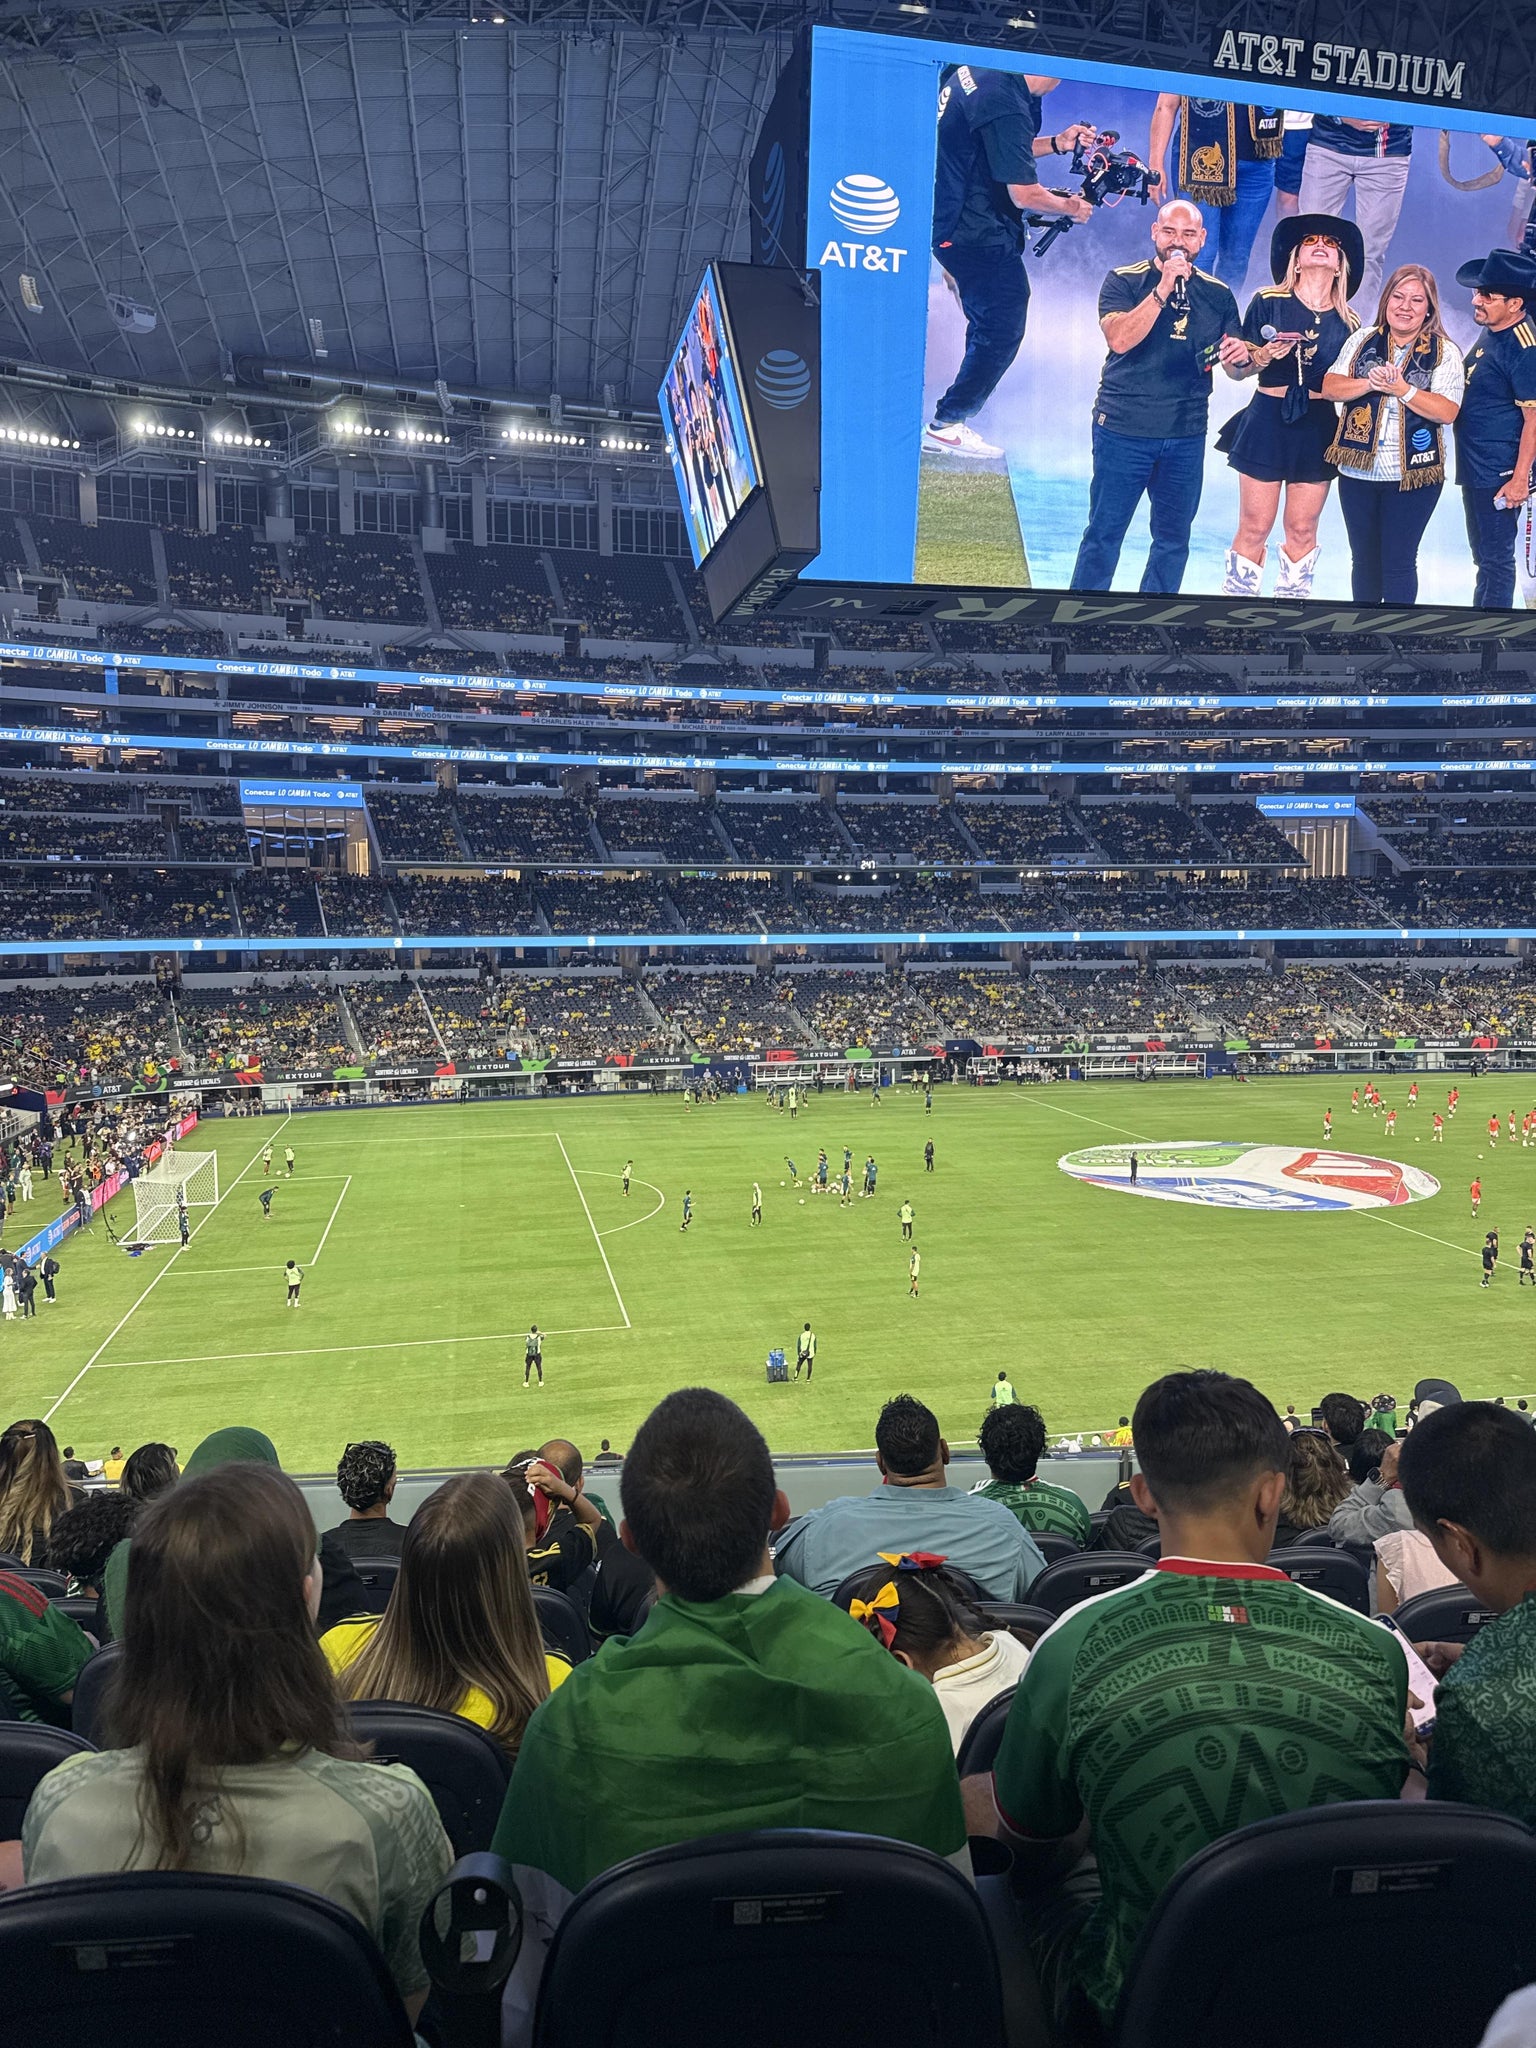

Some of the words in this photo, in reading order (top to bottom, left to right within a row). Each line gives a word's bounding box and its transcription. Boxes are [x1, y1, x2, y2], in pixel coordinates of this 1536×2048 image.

[1213, 29, 1305, 78] AT&T
[1310, 41, 1466, 100] STADIUM
[1258, 118, 1279, 130] AT&T
[819, 240, 908, 273] AT&T
[1410, 450, 1436, 465] AT&T
[731, 568, 797, 616] WINSTAR
[33, 648, 44, 657] LO
[46, 649, 78, 661] CAMBIA
[80, 653, 104, 663] Todo
[123, 657, 141, 665] AT&T
[216, 663, 255, 673] Conectar
[258, 664, 268, 673] LO
[270, 664, 298, 675] CAMBIA
[301, 668, 322, 677] Todo
[419, 676, 454, 685] Conectar
[457, 676, 466, 686] LO
[468, 677, 494, 687] CAMBIA
[496, 680, 516, 689] Todo
[604, 686, 636, 695] Conectar
[639, 687, 647, 695] LO
[649, 687, 673, 697] CAMBIA
[781, 693, 813, 701] Conectar
[815, 694, 823, 702] LO
[824, 694, 847, 702] CAMBIA
[978, 697, 986, 705] LO
[987, 697, 1011, 705] CAMBIA
[1109, 698, 1138, 706] Conectar
[1140, 697, 1149, 706] LO
[1150, 697, 1173, 706] CAMBIA
[1309, 697, 1317, 705] LO
[1318, 697, 1341, 705] CAMBIA
[1485, 696, 1510, 704] CAMBIA
[222, 701, 245, 709] JIMMY
[246, 702, 283, 711] JOHNSON
[383, 710, 413, 718] DARREN
[415, 711, 451, 719] WOODSON
[541, 718, 571, 726] CHARLES
[21, 730, 32, 739] LO
[34, 731, 66, 741] CAMBIA
[69, 735, 93, 743] Todo
[206, 741, 246, 750] Conectar
[248, 741, 259, 750] LO
[260, 742, 289, 751] CAMBIA
[292, 744, 313, 752] Todo
[411, 750, 447, 758] Conectar
[461, 751, 487, 760] CAMBIA
[489, 753, 509, 761] Todo
[597, 757, 630, 765] Conectar
[642, 758, 667, 766] CAMBIA
[819, 762, 842, 770] CAMBIA
[287, 789, 311, 797] CAMBIA
[468, 1063, 510, 1071] MEXTOUR
[277, 1072, 322, 1080] MEXTOUR
[102, 1085, 122, 1094] AT&T
